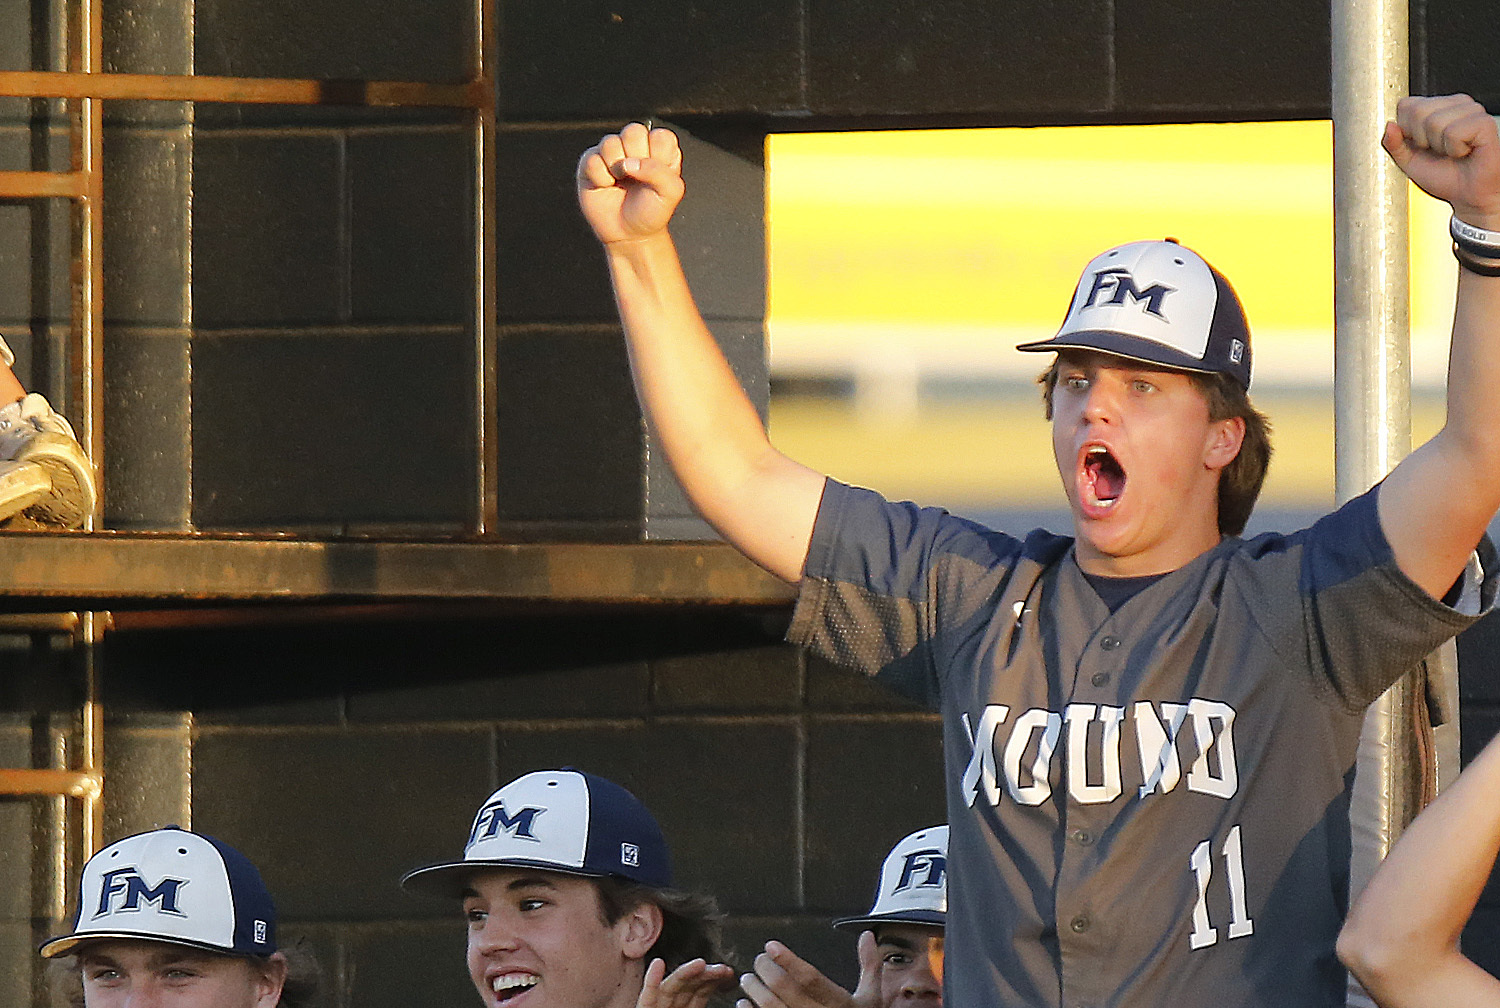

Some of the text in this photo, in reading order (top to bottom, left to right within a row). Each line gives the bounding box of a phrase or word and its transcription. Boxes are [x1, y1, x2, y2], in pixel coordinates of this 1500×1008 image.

[1080, 268, 1178, 323] FM
[962, 698, 1239, 808] MOUND
[464, 799, 548, 848] FM
[92, 865, 190, 920] FM
[1190, 824, 1254, 951] 11
